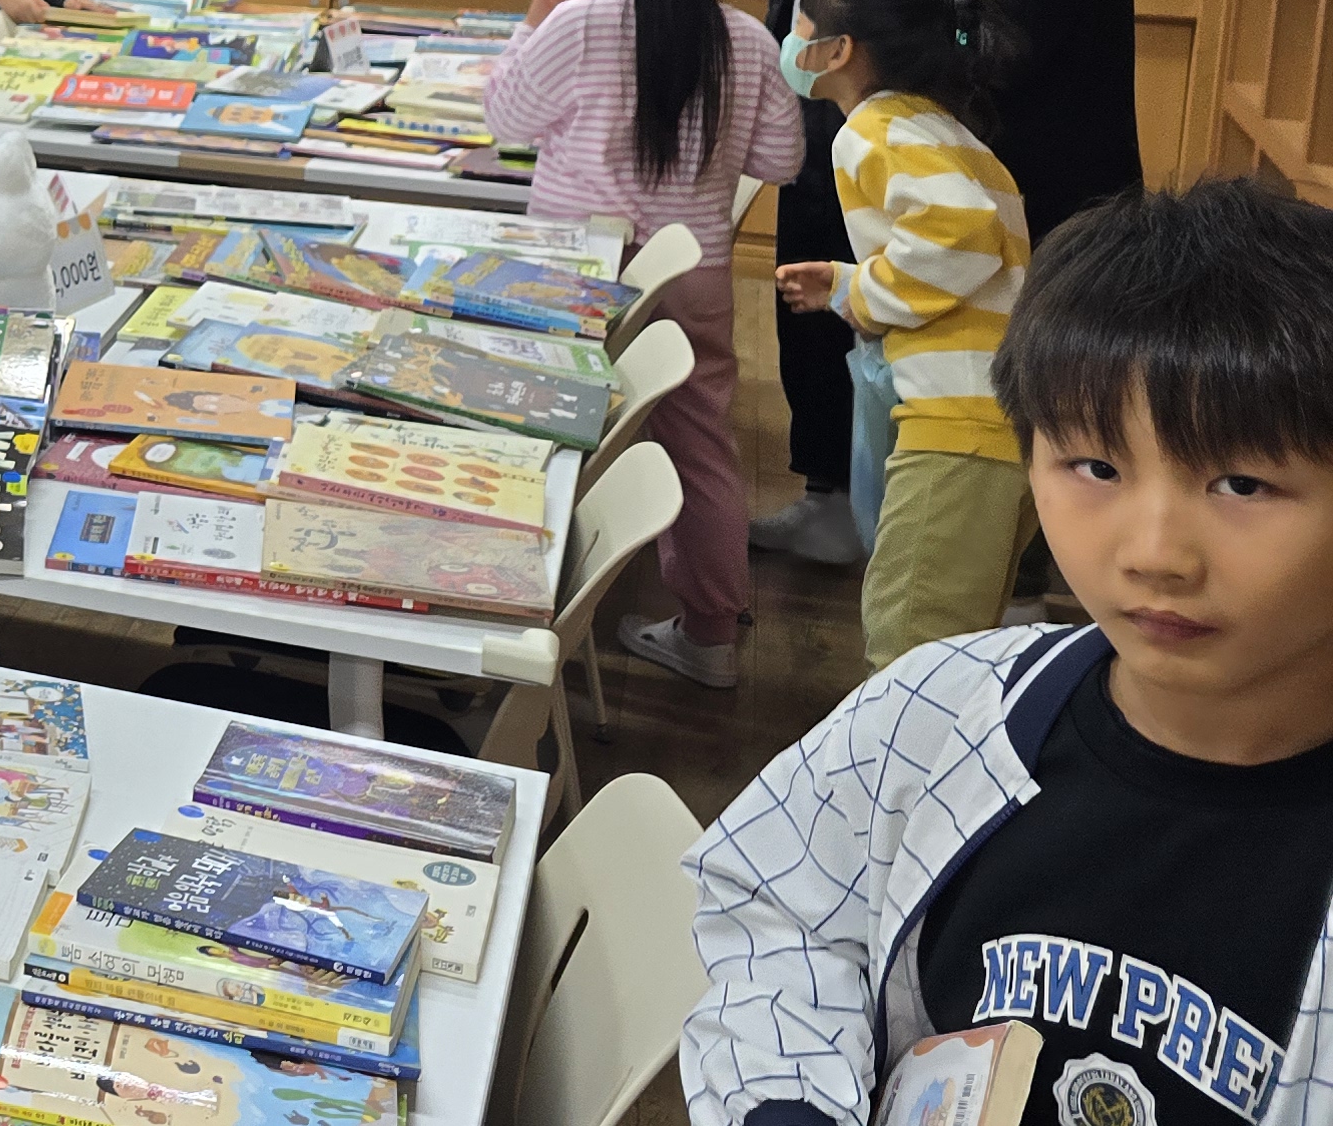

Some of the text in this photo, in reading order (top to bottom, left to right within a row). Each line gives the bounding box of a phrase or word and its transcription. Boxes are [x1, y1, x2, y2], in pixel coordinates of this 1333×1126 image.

[53, 251, 100, 298] ,000원
[159, 889, 215, 918] 얼음
[171, 868, 227, 898] 왕국이
[60, 944, 82, 961] 톰
[87, 949, 137, 977] 소여의
[147, 963, 186, 985] 모험
[972, 934, 1113, 1030] NEW
